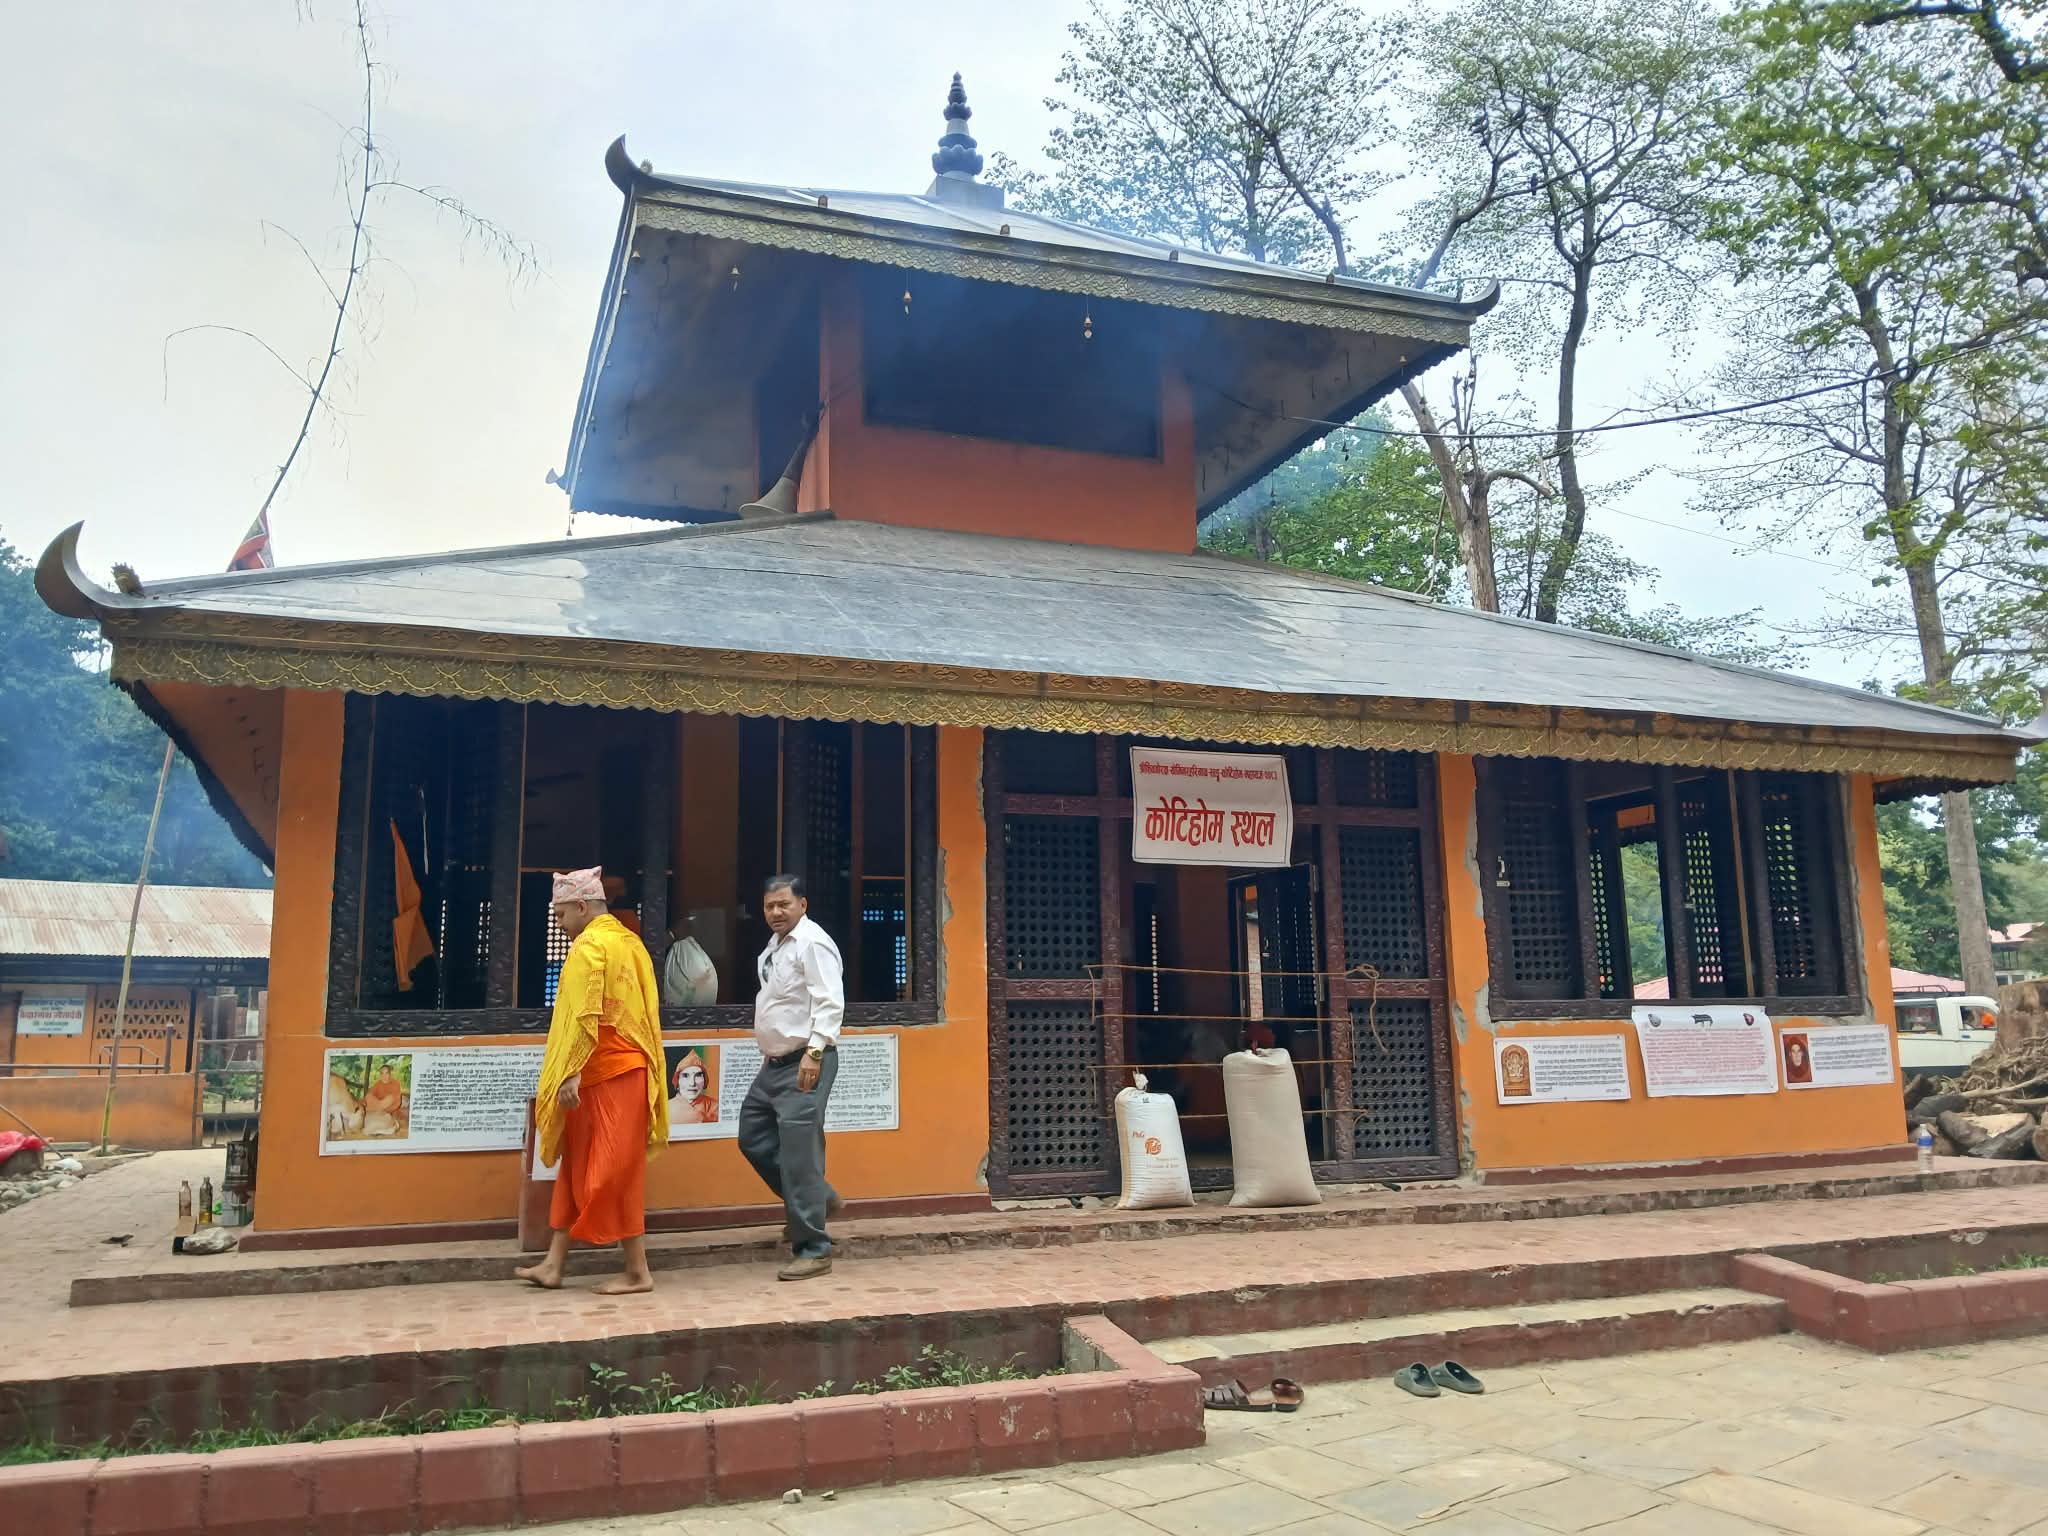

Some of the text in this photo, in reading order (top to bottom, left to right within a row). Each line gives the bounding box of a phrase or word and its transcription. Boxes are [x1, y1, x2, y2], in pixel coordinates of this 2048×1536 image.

[1145, 796, 1276, 847] कोटिहोम स्थल
[1145, 1138, 1162, 1155] Tide
